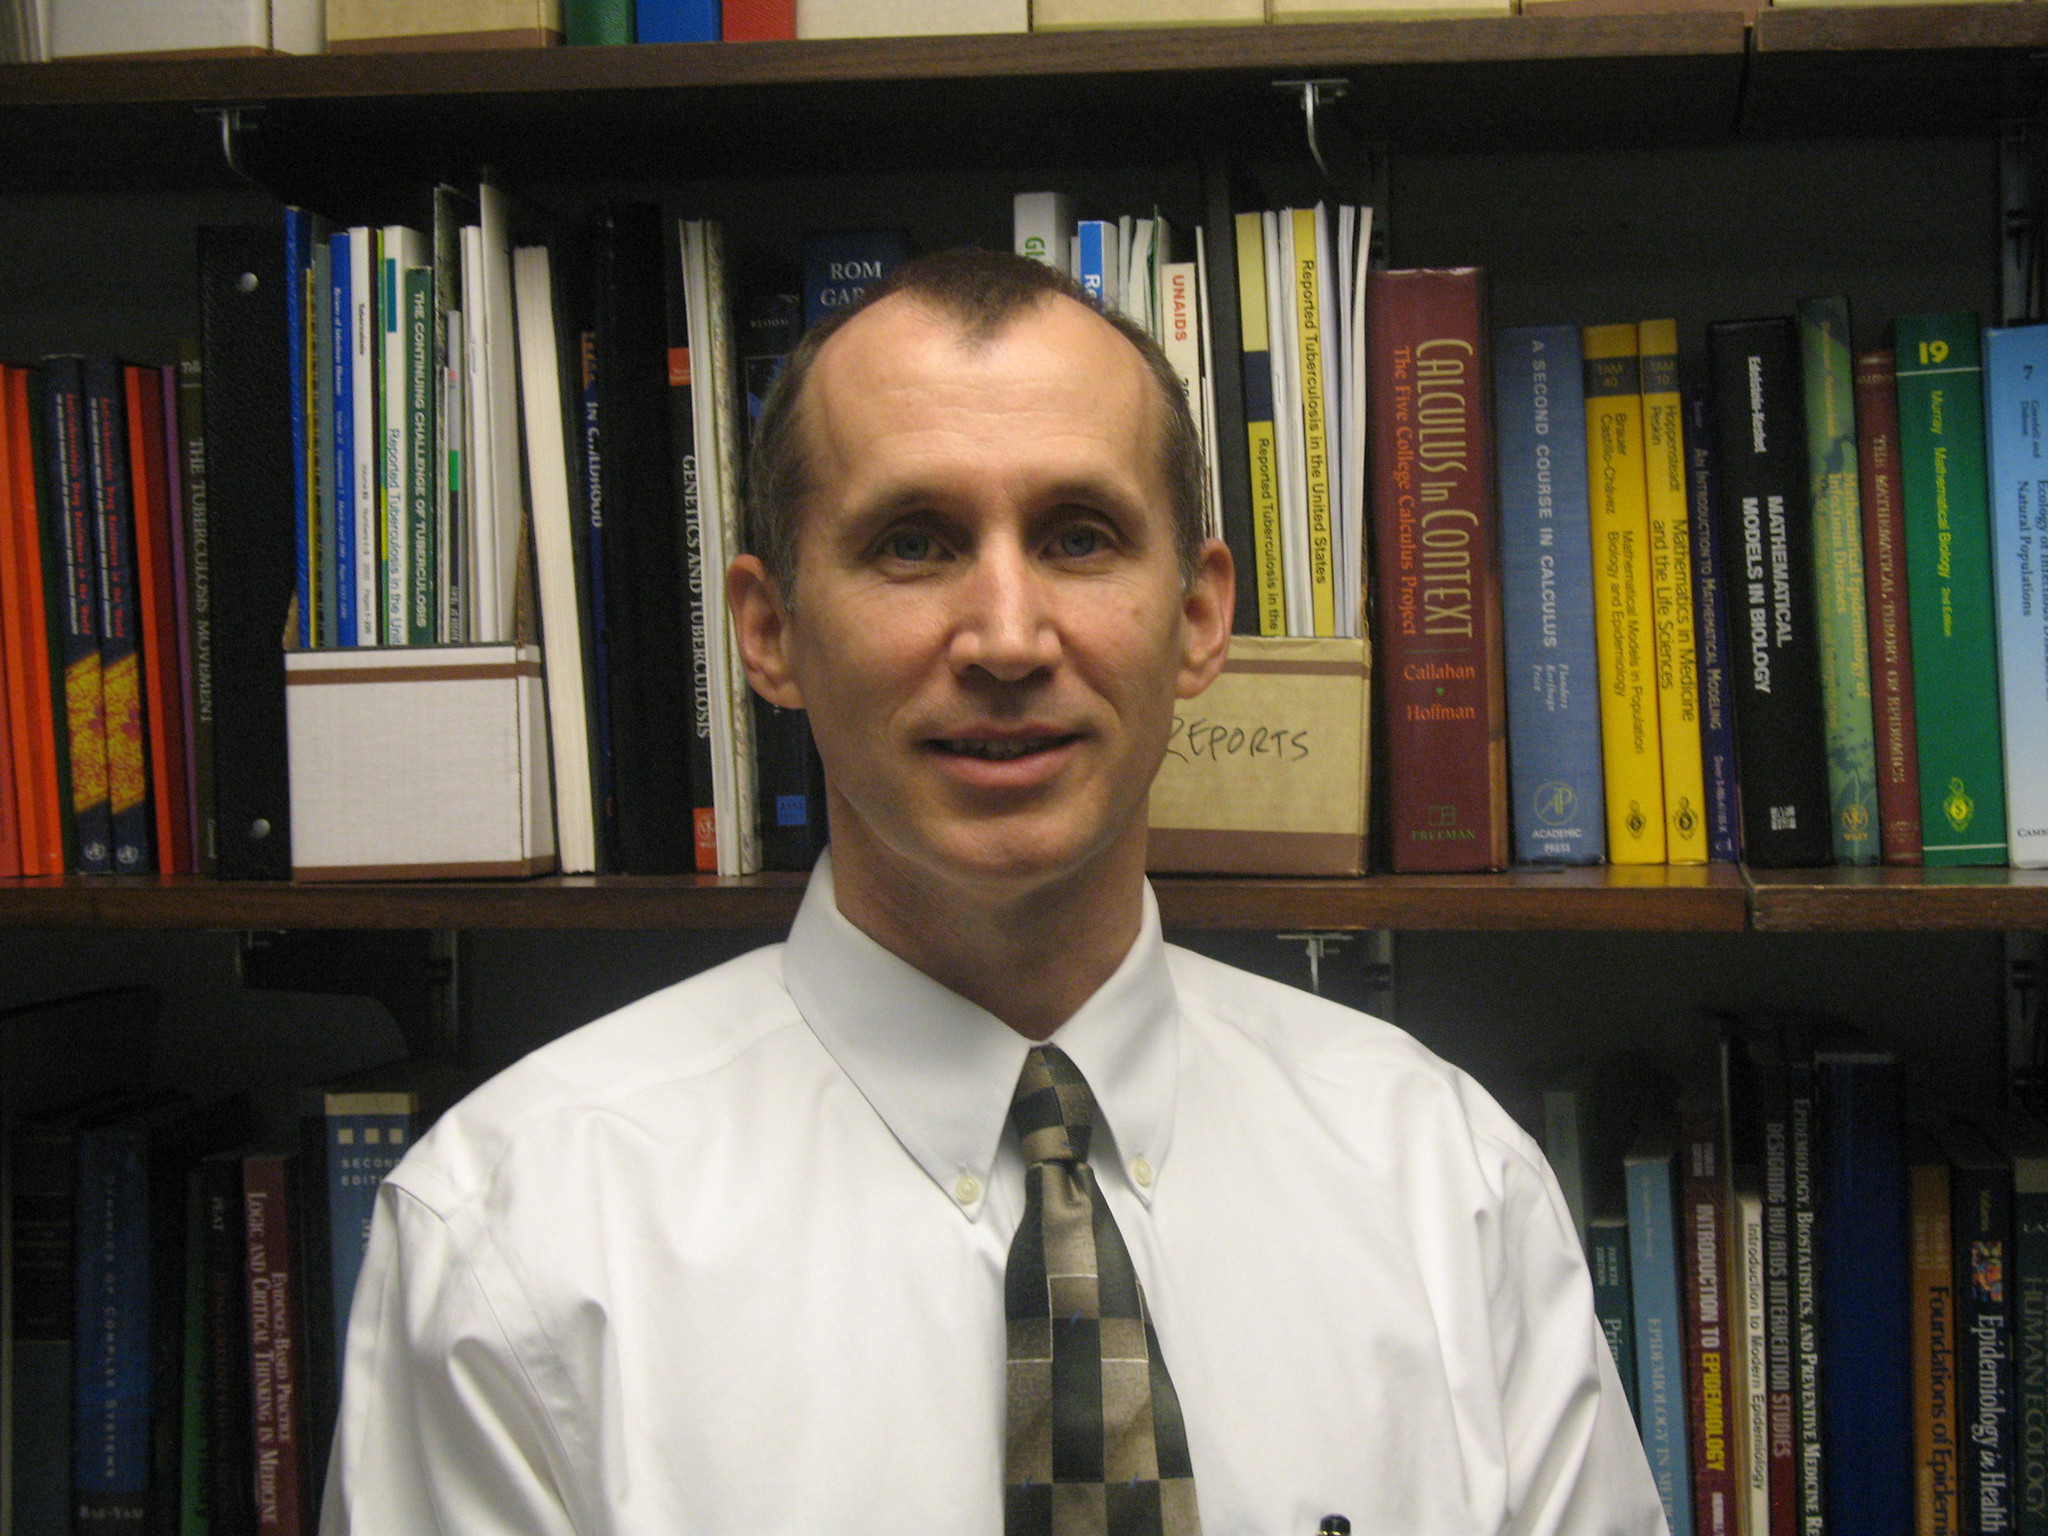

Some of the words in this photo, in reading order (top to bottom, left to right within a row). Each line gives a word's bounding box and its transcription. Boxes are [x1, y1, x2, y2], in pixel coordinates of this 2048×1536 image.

[830, 260, 883, 280] ROM
[1301, 259, 1319, 330] Reported
[358, 303, 366, 355] Tuberculosis
[414, 291, 425, 319] THE
[1171, 274, 1188, 342] UNAIDS
[414, 321, 426, 410] CONTINUING
[1394, 345, 1411, 379] The
[1531, 340, 1545, 353] A
[1918, 340, 1950, 365] 19
[586, 401, 599, 421] IN
[1304, 333, 1322, 432] Tuberculosis
[1395, 385, 1413, 420] Five
[1416, 338, 1473, 473] CALCULUS
[1532, 360, 1549, 436] SECOND
[1747, 356, 1768, 453] Edelstein-Keshet
[1930, 390, 1944, 434] Murray
[414, 411, 427, 497] CHALLENGE
[1310, 435, 1323, 450] in
[1615, 413, 1629, 456] Brauer
[1649, 405, 1662, 446] Peskin
[1664, 404, 1682, 492] Hoppensteadt
[1872, 434, 1888, 468] THE
[2032, 441, 2043, 459] and
[189, 436, 206, 476] THE
[387, 429, 402, 488] Reported
[1257, 437, 1273, 500] Reported
[1311, 454, 1325, 478] the
[1393, 426, 1415, 489] College
[1536, 444, 1552, 519] COURSE
[1600, 413, 1617, 514] Castillo-Chávez
[70, 482, 82, 506] Drug
[104, 485, 116, 510] Drug
[415, 499, 427, 520] OF
[682, 455, 701, 548] GENETICS
[1312, 483, 1328, 532] United
[1828, 472, 1845, 549] Infectious
[1934, 447, 1951, 530] Mathematical
[2016, 480, 2033, 531] Natural
[73, 510, 85, 563] Resistance
[107, 514, 119, 567] Resistance
[191, 480, 210, 613] TUBERCULOSIS
[389, 491, 403, 575] Tuberculosis
[1262, 503, 1278, 588] Tuberculosis
[1398, 495, 1417, 570] Calculus
[1539, 527, 1554, 546] IN
[1653, 520, 1669, 549] and
[1742, 497, 1764, 580] MODELS
[1844, 472, 1862, 573] Mathematical
[391, 578, 403, 590] in
[415, 520, 428, 628] TUBERCULOSIS
[686, 553, 705, 593] AND
[1315, 537, 1329, 584] States
[1421, 508, 1479, 638] CONTEXT
[1606, 531, 1623, 579] Biology
[1622, 530, 1640, 616] Mathematical
[1655, 556, 1671, 581] the
[1672, 519, 1693, 626] Mathematics
[1767, 495, 1793, 648] MATHEMATICAL
[1833, 550, 1848, 613] Diseases
[1937, 532, 1953, 578] Biology
[2015, 535, 2034, 617] Populations
[79, 583, 88, 599] the
[80, 605, 92, 635] World
[112, 587, 122, 603] the
[391, 594, 403, 614] the
[1267, 593, 1279, 605] in
[1268, 609, 1280, 631] the
[1398, 576, 1419, 636] Project
[1540, 555, 1558, 648] CALCULUS
[1611, 583, 1625, 607] and
[1657, 587, 1675, 615] Life
[1748, 582, 1766, 603] IN
[114, 608, 126, 638] World
[1626, 620, 1642, 667] Models
[1678, 629, 1694, 643] in
[1701, 577, 1717, 666] MATHEMATICAL
[1749, 608, 1771, 694] BIOLOGY
[1849, 576, 1868, 678] Epidemiology
[1882, 602, 1899, 664] THEORY
[1942, 606, 1953, 637] Edition
[197, 620, 214, 723] MOVEMENT
[688, 599, 711, 739] TUBERCULOSIS
[1404, 663, 1476, 682] Callahan
[1532, 664, 1544, 693] Price
[1612, 611, 1630, 698] Epidemiology
[1630, 671, 1644, 683] in
[1659, 620, 1678, 690] Sciences
[1886, 670, 1900, 692] OF
[1406, 703, 1476, 721] Hoffman
[1558, 663, 1570, 709] Flanders
[1680, 648, 1698, 722] Medicine
[1706, 669, 1723, 730] MODELING
[1856, 682, 1870, 698] of
[1629, 686, 1647, 754] Population
[1887, 696, 1906, 784] EPIDEMICS
[1532, 827, 1583, 840] ACADEMIC
[1543, 841, 1571, 853] PRESS
[341, 1157, 402, 1170] SECON
[1767, 1122, 1787, 1204] DESIGNING
[247, 1192, 267, 1239] LOGIC
[1768, 1206, 1789, 1278] HIV/AIDS
[250, 1242, 266, 1273] AND
[1695, 1203, 1719, 1322] INTRODUCTION
[1747, 1223, 1763, 1310] Introduction
[251, 1276, 272, 1345] CRITICAL
[271, 1272, 291, 1380] EVIDENCE-BASED
[1701, 1326, 1720, 1349] TO
[1750, 1316, 1763, 1329] to
[1769, 1280, 1791, 1391] INTERVENTION
[1800, 1322, 1815, 1351] AND
[2023, 1276, 2047, 1385] HUMAN
[1648, 1318, 1670, 1445] EPIDEMIOLOGY
[1750, 1334, 1765, 1389] Modern
[1928, 1285, 1950, 1419] Foundations
[1970, 1313, 2007, 1449] Epidemiology
[254, 1348, 276, 1421] THINKING
[276, 1382, 293, 1443] PRACTICE
[1702, 1352, 1726, 1472] EPIDEMIOLOGY
[1801, 1352, 1819, 1441] PREVENTIVE
[257, 1426, 274, 1443] IN
[1751, 1394, 1768, 1492] Epidemiology
[1772, 1393, 1792, 1458] STUDIES
[1933, 1422, 1953, 1446] of
[1656, 1447, 1671, 1466] IN
[1804, 1441, 1822, 1513] MEDICINE
[1980, 1449, 2002, 1471] in
[2024, 1394, 2047, 1520] ECOLOGY
[259, 1447, 280, 1526] MEDICINE
[1979, 1471, 2008, 1533] Health
